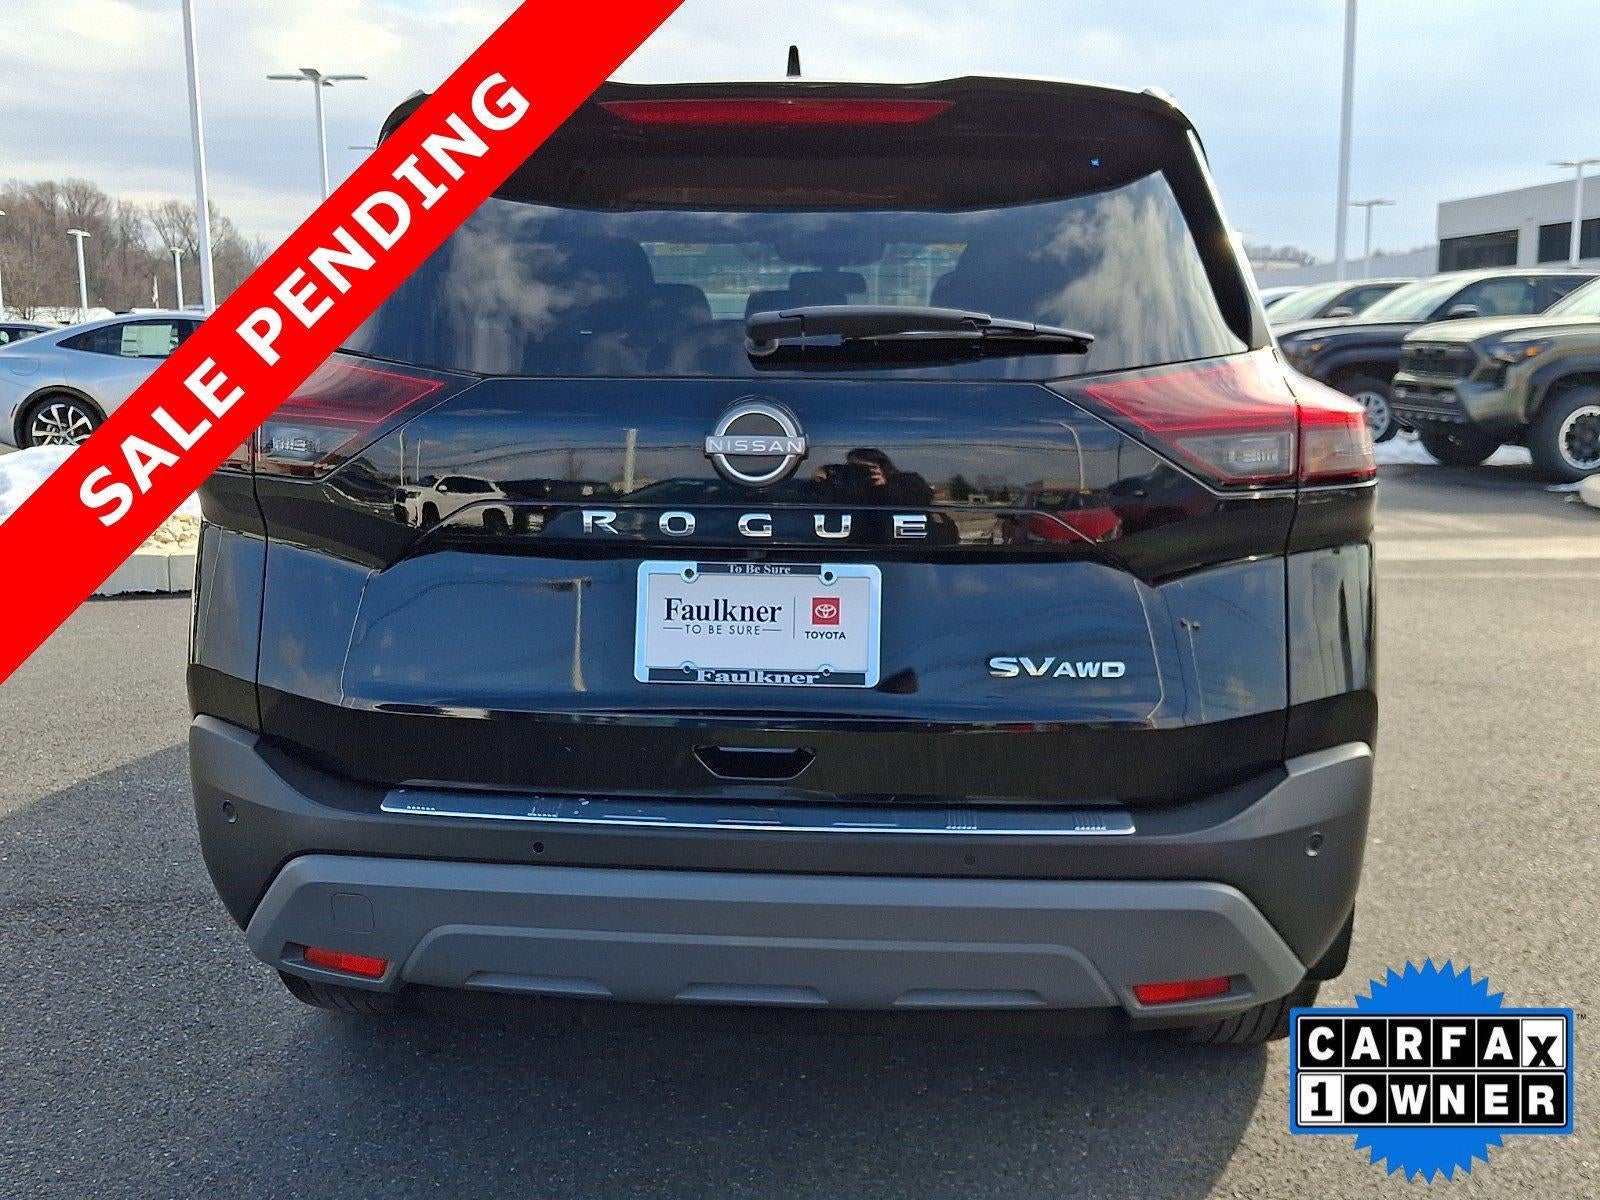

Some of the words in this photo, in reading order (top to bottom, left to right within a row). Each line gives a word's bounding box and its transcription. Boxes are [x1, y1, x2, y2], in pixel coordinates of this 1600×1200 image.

[707, 438, 804, 453] NISSAN
[582, 509, 928, 539] ROGUE
[728, 564, 743, 574] To
[745, 564, 760, 574] Be
[763, 564, 791, 575] Sure
[664, 597, 782, 623] Faulkner
[685, 624, 702, 635] TO
[708, 624, 723, 635] BE
[729, 625, 761, 636] SURE
[804, 631, 847, 640] TOYOTA
[989, 656, 1055, 678] SV
[1052, 661, 1126, 678] AWD
[696, 669, 821, 685] Faulkner
